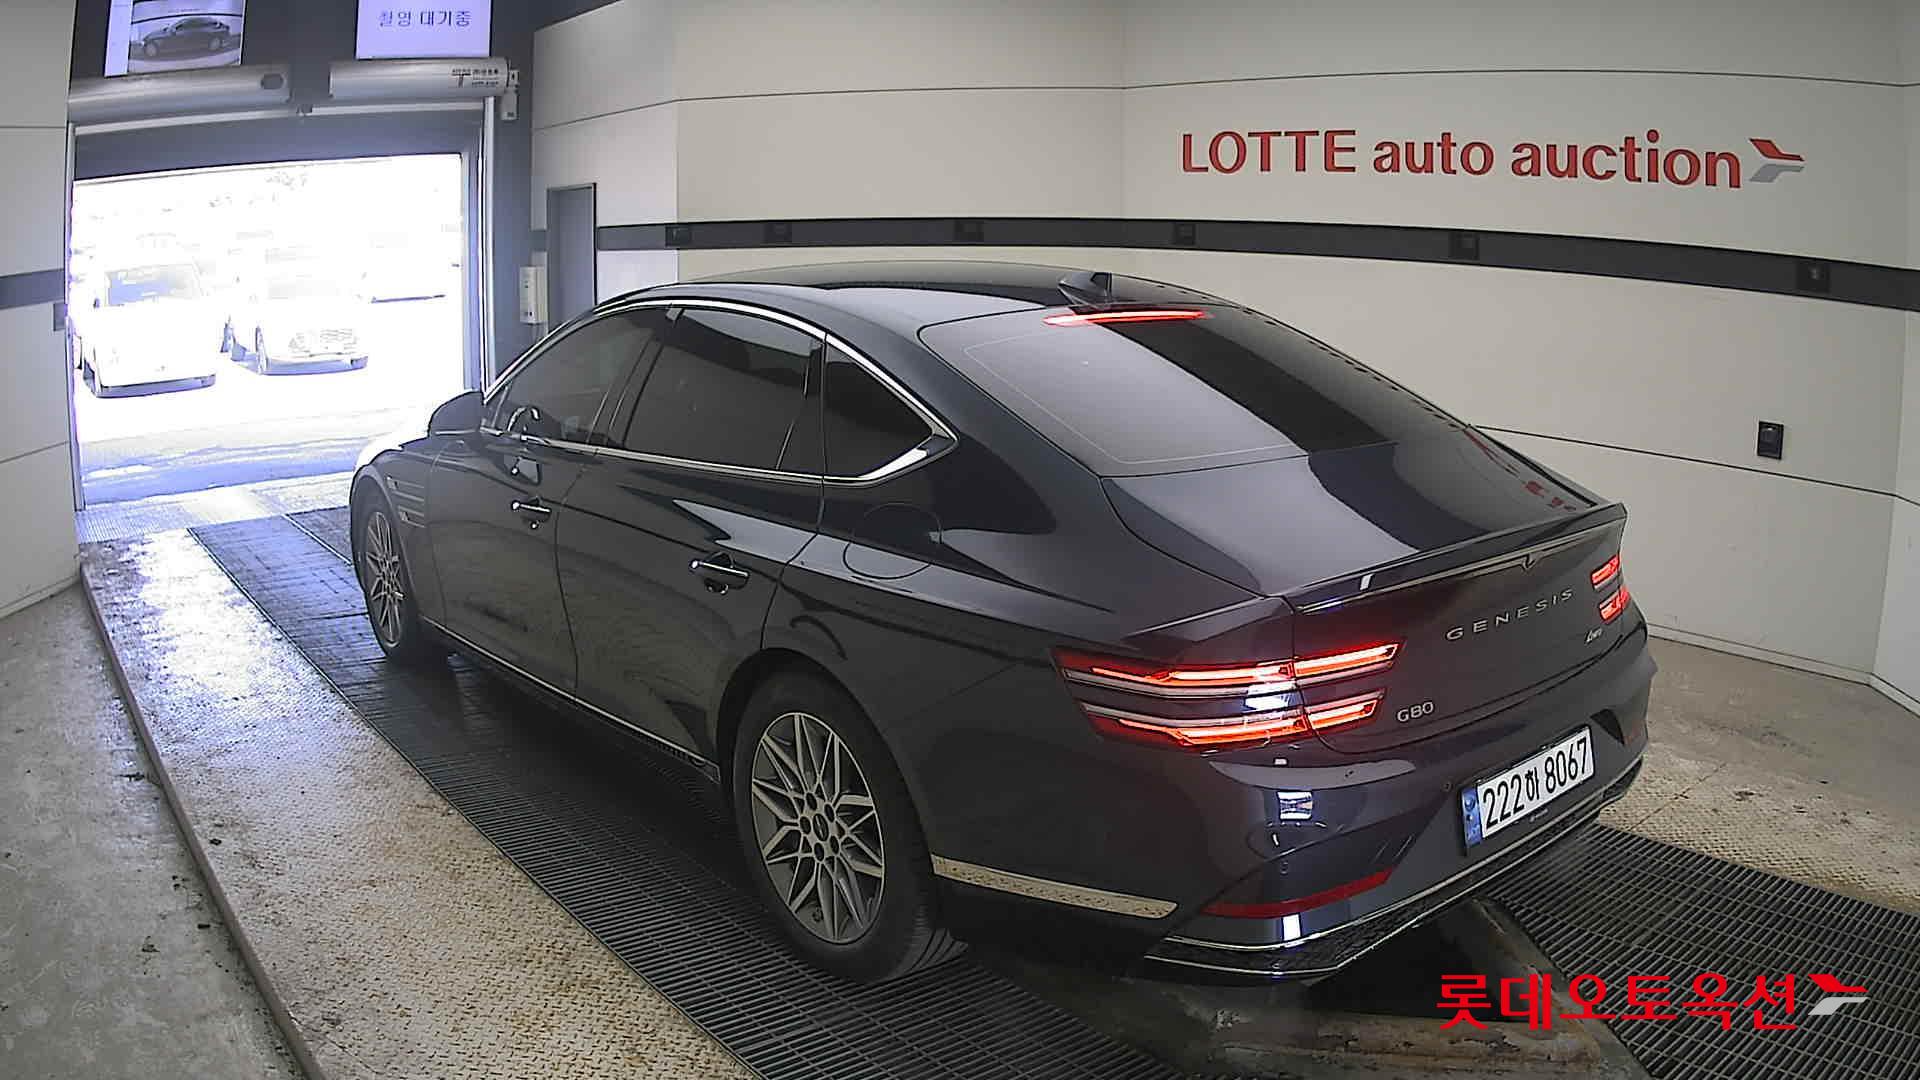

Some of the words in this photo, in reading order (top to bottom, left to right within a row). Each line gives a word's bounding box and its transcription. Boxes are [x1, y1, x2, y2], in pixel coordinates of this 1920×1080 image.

[420, 9, 472, 27] 대기중
[1182, 129, 1356, 174] LOTTE
[1373, 132, 1494, 175] auto
[1511, 129, 1742, 189] auction
[1446, 588, 1574, 641] GENESIS
[1396, 701, 1435, 723] G80
[1544, 736, 1587, 794] 8067
